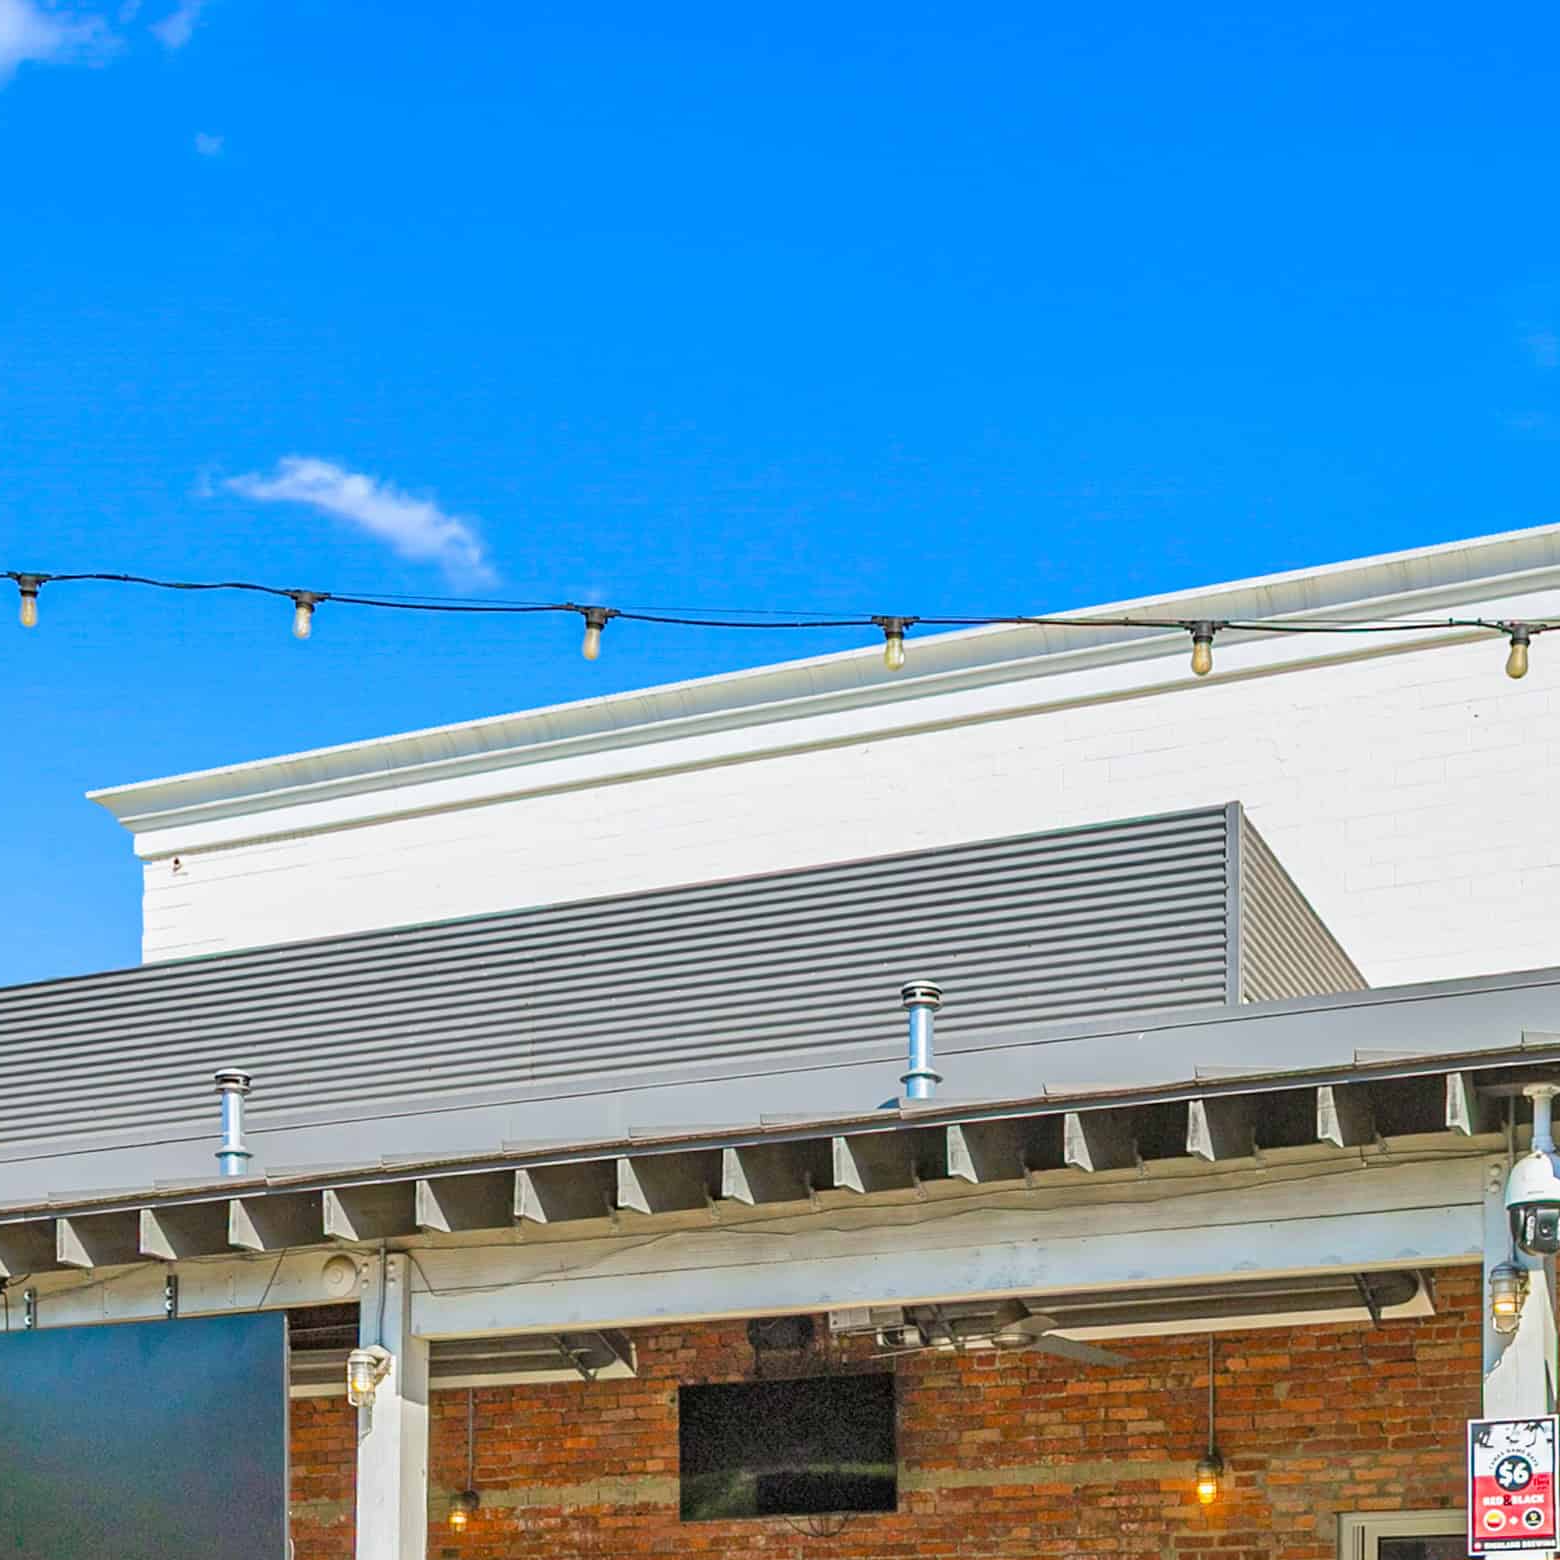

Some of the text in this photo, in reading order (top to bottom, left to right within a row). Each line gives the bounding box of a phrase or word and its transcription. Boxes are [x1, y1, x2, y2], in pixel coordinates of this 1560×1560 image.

[1497, 1460, 1530, 1487] $6
[1483, 1494, 1545, 1507] RED & BLACK
